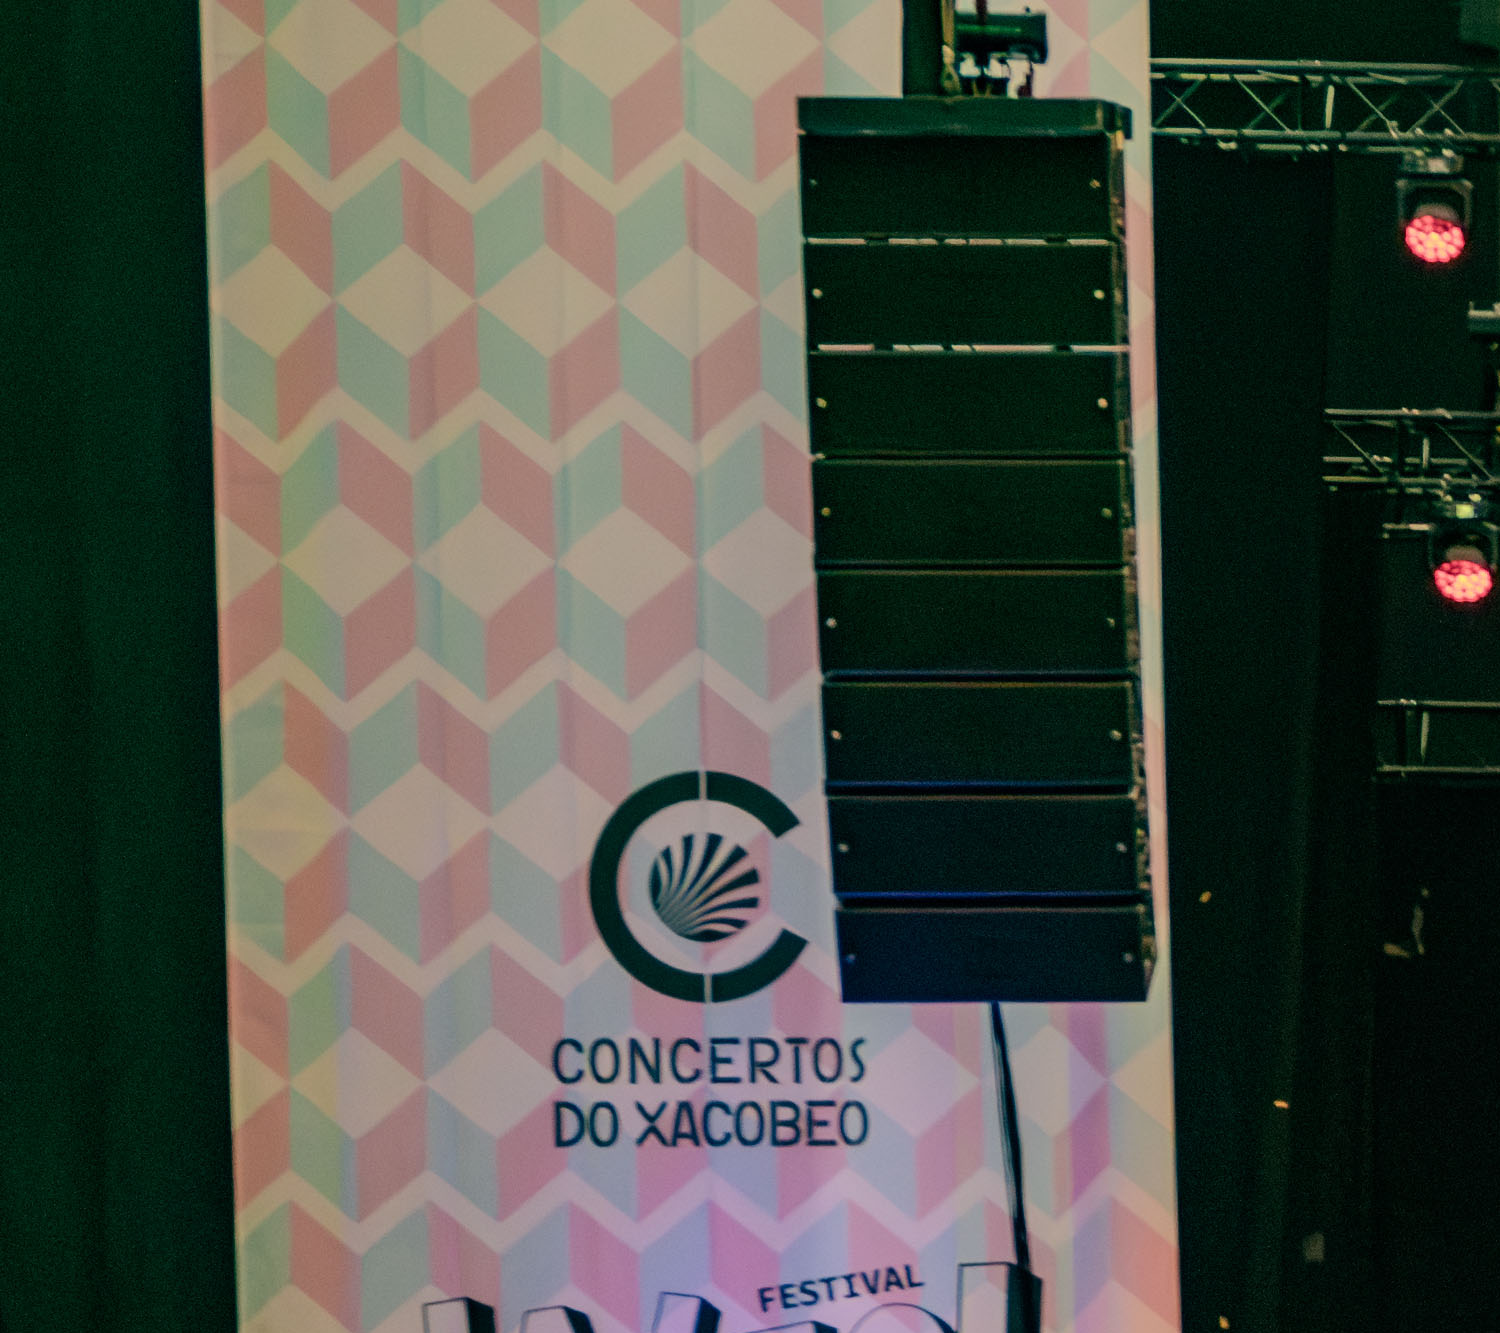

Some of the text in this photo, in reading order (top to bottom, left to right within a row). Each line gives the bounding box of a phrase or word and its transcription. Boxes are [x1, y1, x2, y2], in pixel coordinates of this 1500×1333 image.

[552, 1037, 866, 1085] CONCERTOS
[553, 1100, 868, 1147] DO XACOBEO
[756, 1264, 926, 1313] FESTIVAL
